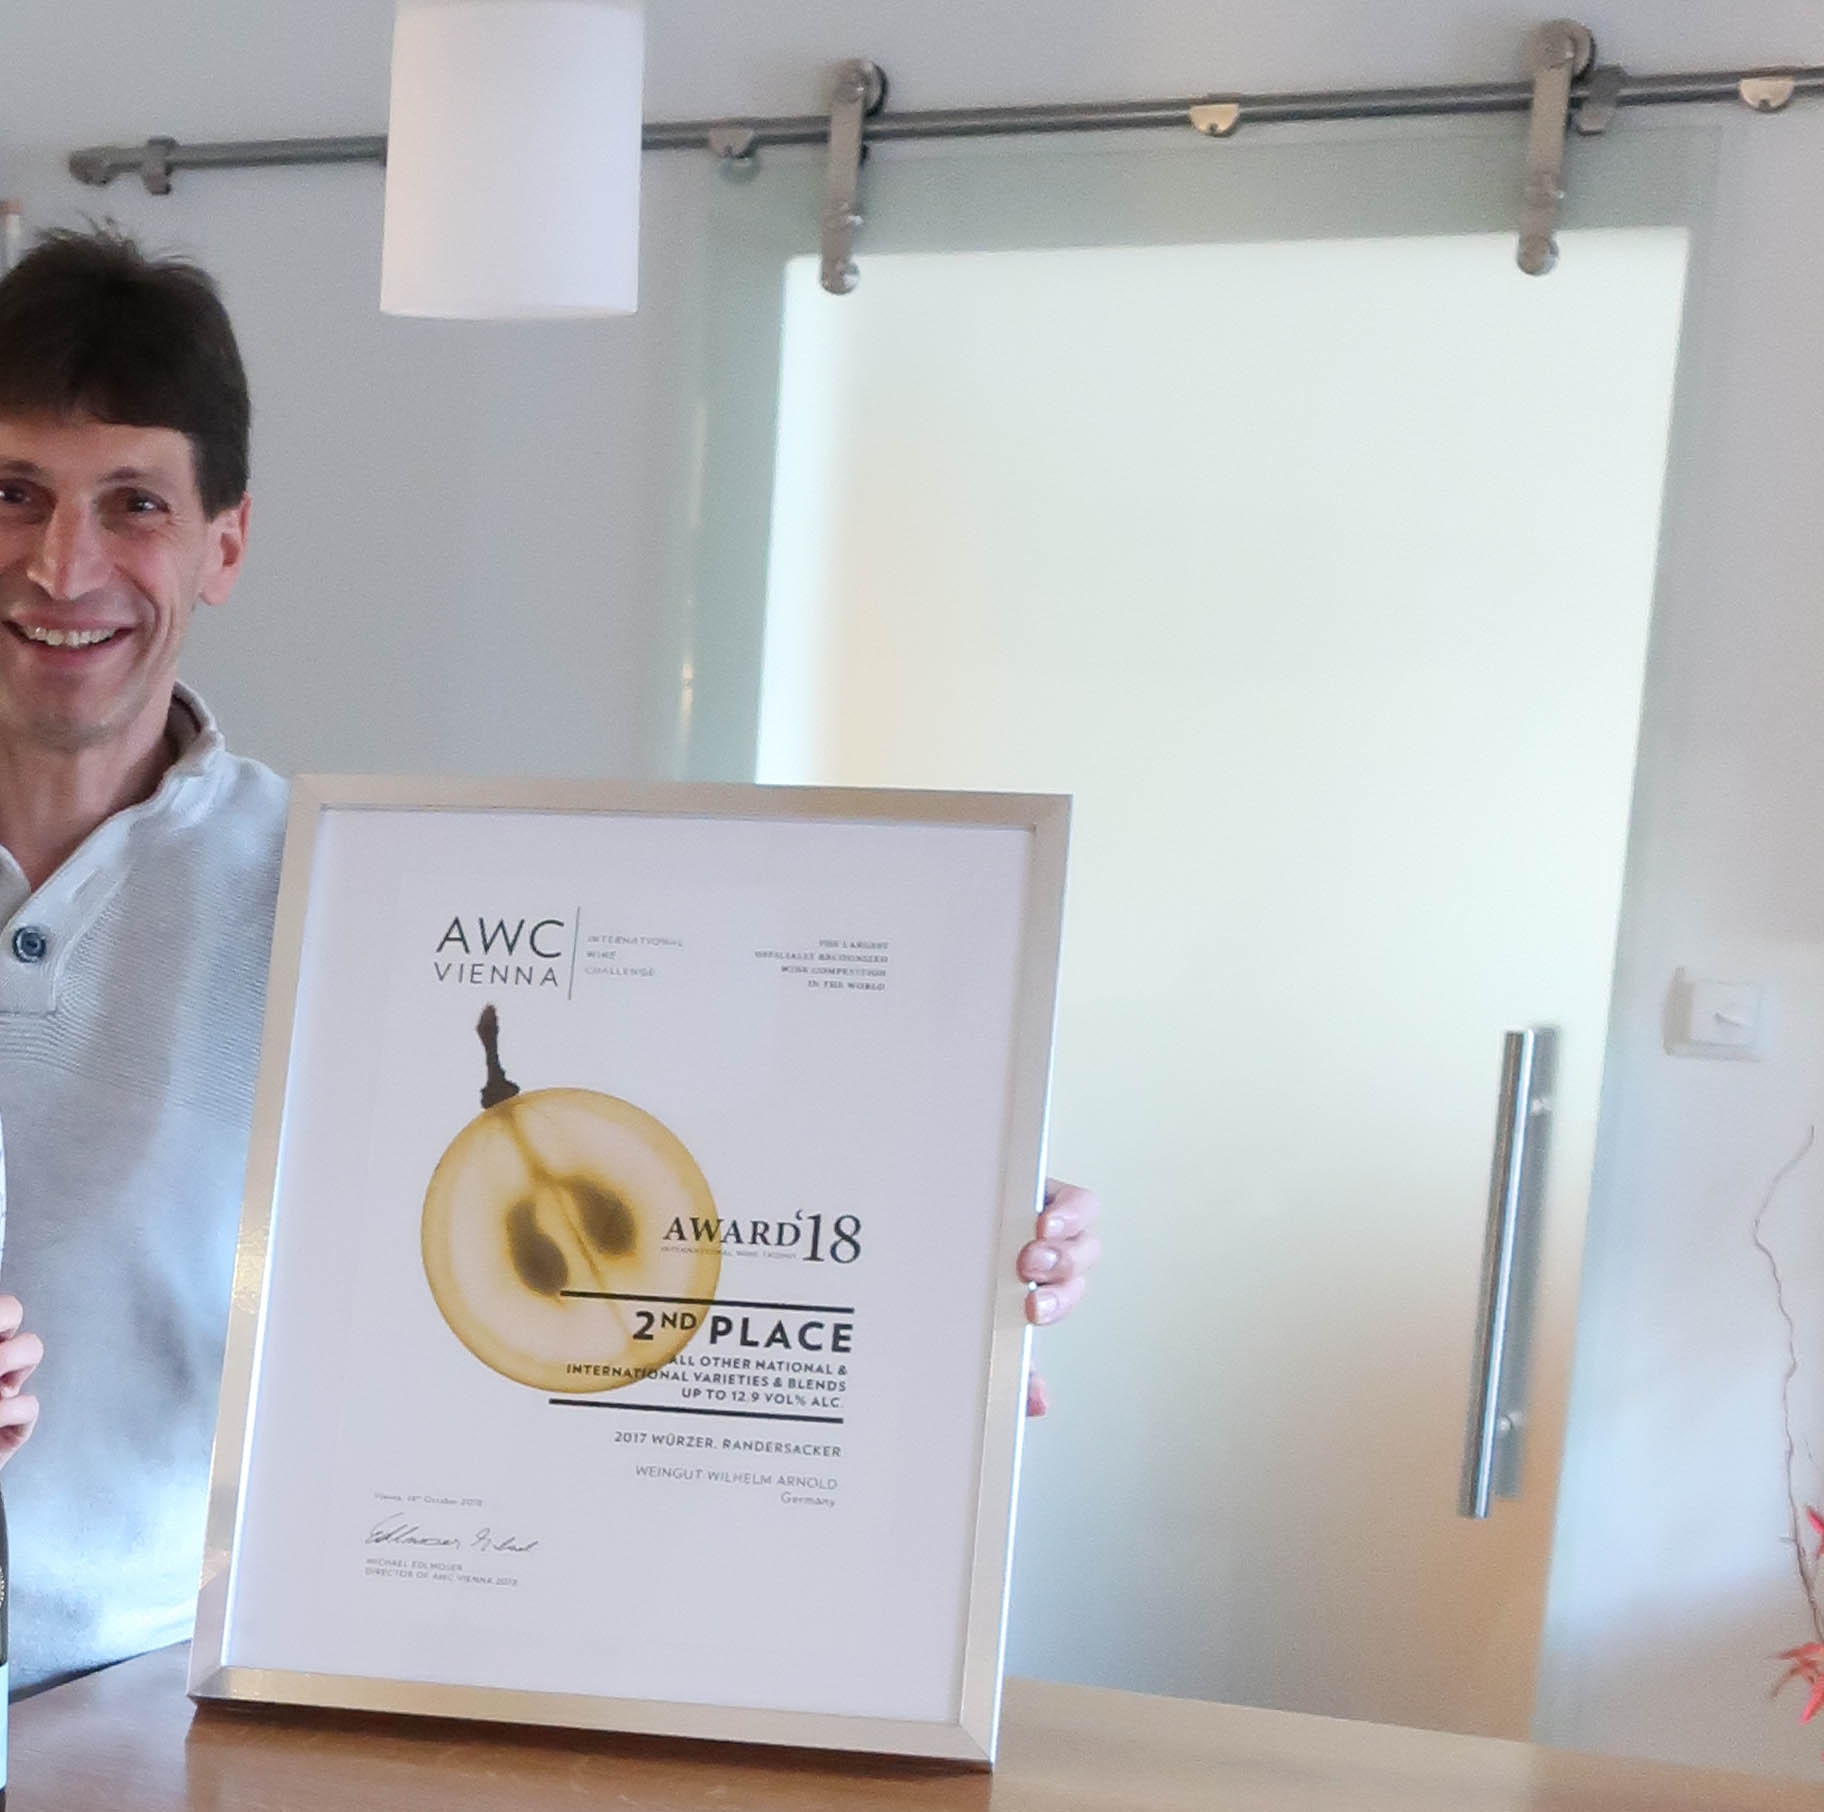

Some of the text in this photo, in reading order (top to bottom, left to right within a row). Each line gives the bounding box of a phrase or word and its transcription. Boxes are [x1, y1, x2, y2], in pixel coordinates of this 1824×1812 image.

[435, 916, 565, 959] AWC
[434, 961, 558, 987] VIENNA
[632, 1310, 854, 1353] 2ND PLACE
[566, 1362, 689, 1384] INTERNATIONAL
[693, 1371, 769, 1388] VARIETIES
[788, 1377, 847, 1393] BLENDS
[669, 1354, 695, 1367] ALL
[700, 1355, 750, 1370] OTHER
[755, 1359, 833, 1376] NATIONAL
[681, 1387, 702, 1399] UP
[707, 1388, 727, 1401] TO
[614, 1430, 648, 1443] 2017
[722, 1437, 842, 1458] RANDERSACKER
[635, 1465, 838, 1491] WEINGUT WILHELM ARNOLD
[780, 1491, 836, 1509] Germany
